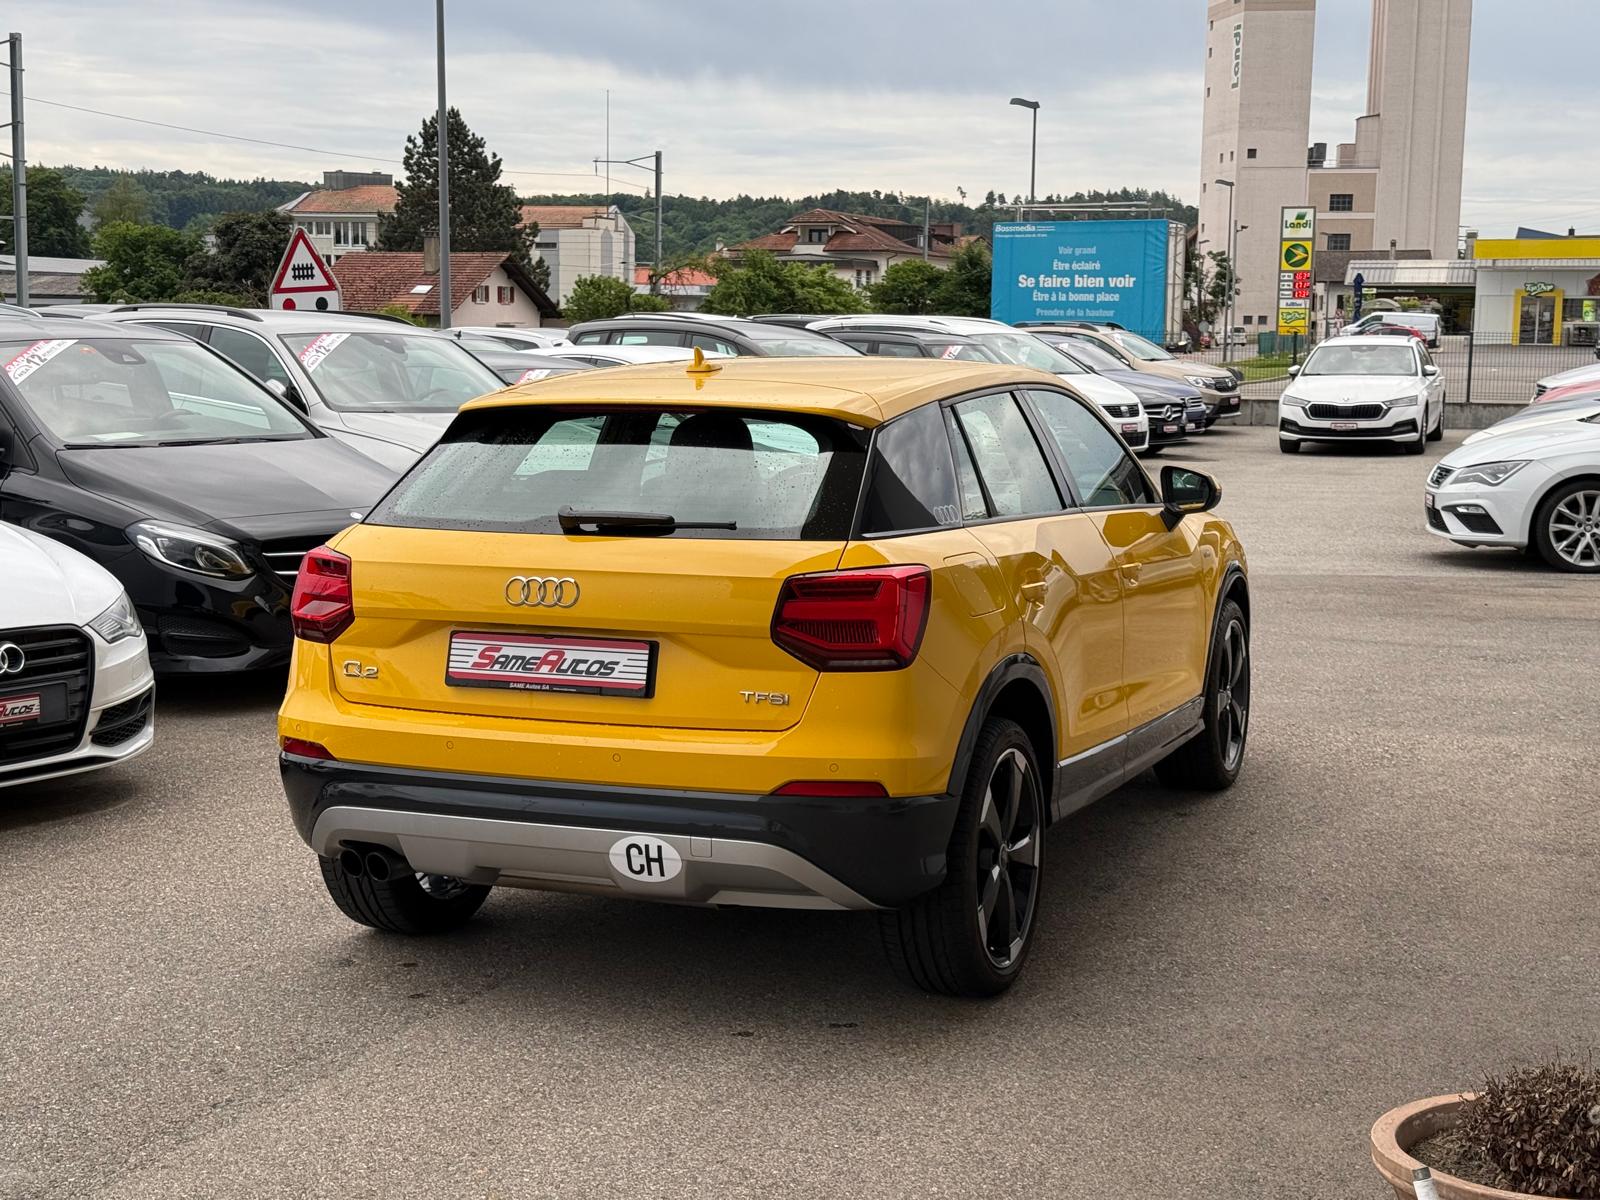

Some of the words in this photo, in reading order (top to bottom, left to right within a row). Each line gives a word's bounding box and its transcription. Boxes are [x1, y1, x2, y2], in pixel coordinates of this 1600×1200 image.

[1231, 23, 1242, 89] Landi
[1284, 220, 1312, 229] Landi
[1058, 246, 1074, 255] Voir
[1074, 246, 1097, 256] grand
[1053, 259, 1071, 271] Être
[1072, 260, 1101, 271] éclairé
[1018, 274, 1036, 288] Se
[1038, 274, 1071, 288] faire
[1074, 274, 1105, 288] bien
[1108, 274, 1137, 288] voir
[1033, 289, 1049, 301] Être
[1050, 291, 1057, 301] à
[1058, 291, 1067, 301] la
[1068, 291, 1095, 301] bonne
[1096, 291, 1120, 303] place
[1036, 308, 1065, 317] Prendre
[1066, 308, 1075, 317] de
[1076, 308, 1085, 317] la
[1086, 308, 1116, 317] hauteur
[26, 354, 48, 366] 12
[343, 660, 379, 679] Q2
[739, 690, 790, 705] TFSI
[625, 843, 665, 877] CH
